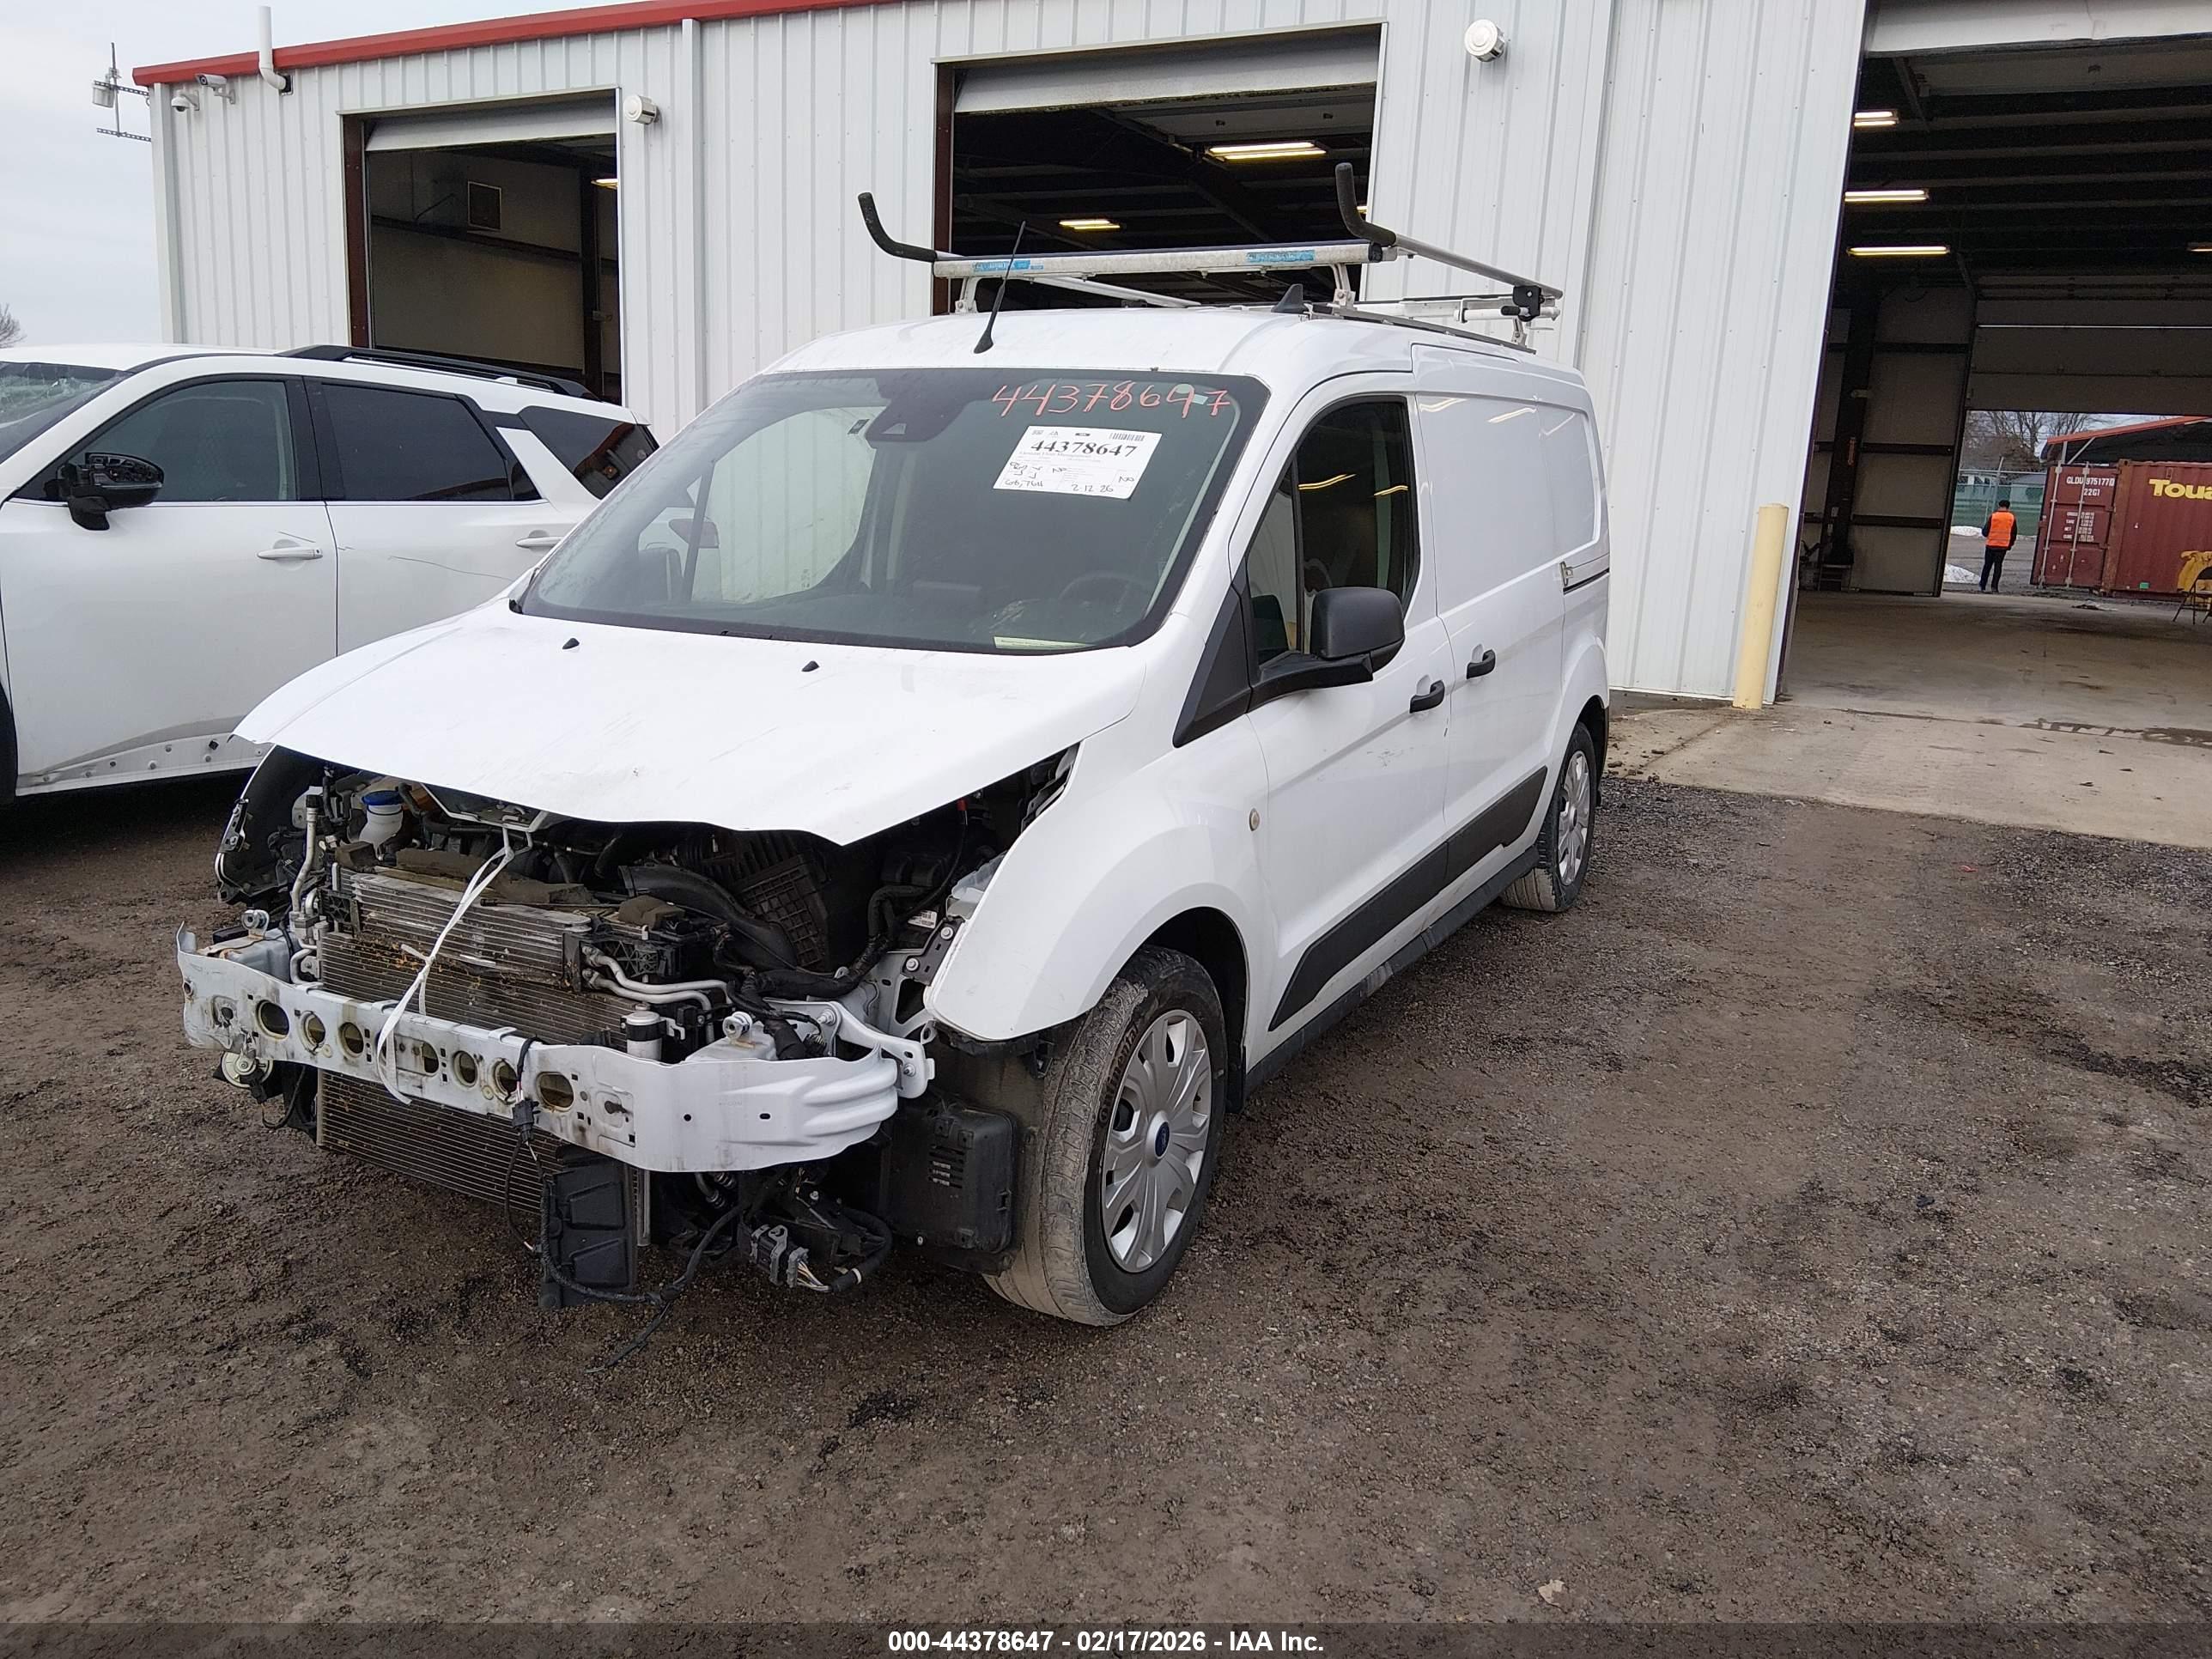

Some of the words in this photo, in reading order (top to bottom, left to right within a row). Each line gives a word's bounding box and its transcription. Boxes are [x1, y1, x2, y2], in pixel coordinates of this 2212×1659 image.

[1030, 440, 1138, 457] 44378647
[2066, 476, 2084, 484] GLDU
[2083, 488, 2100, 496] 22G1
